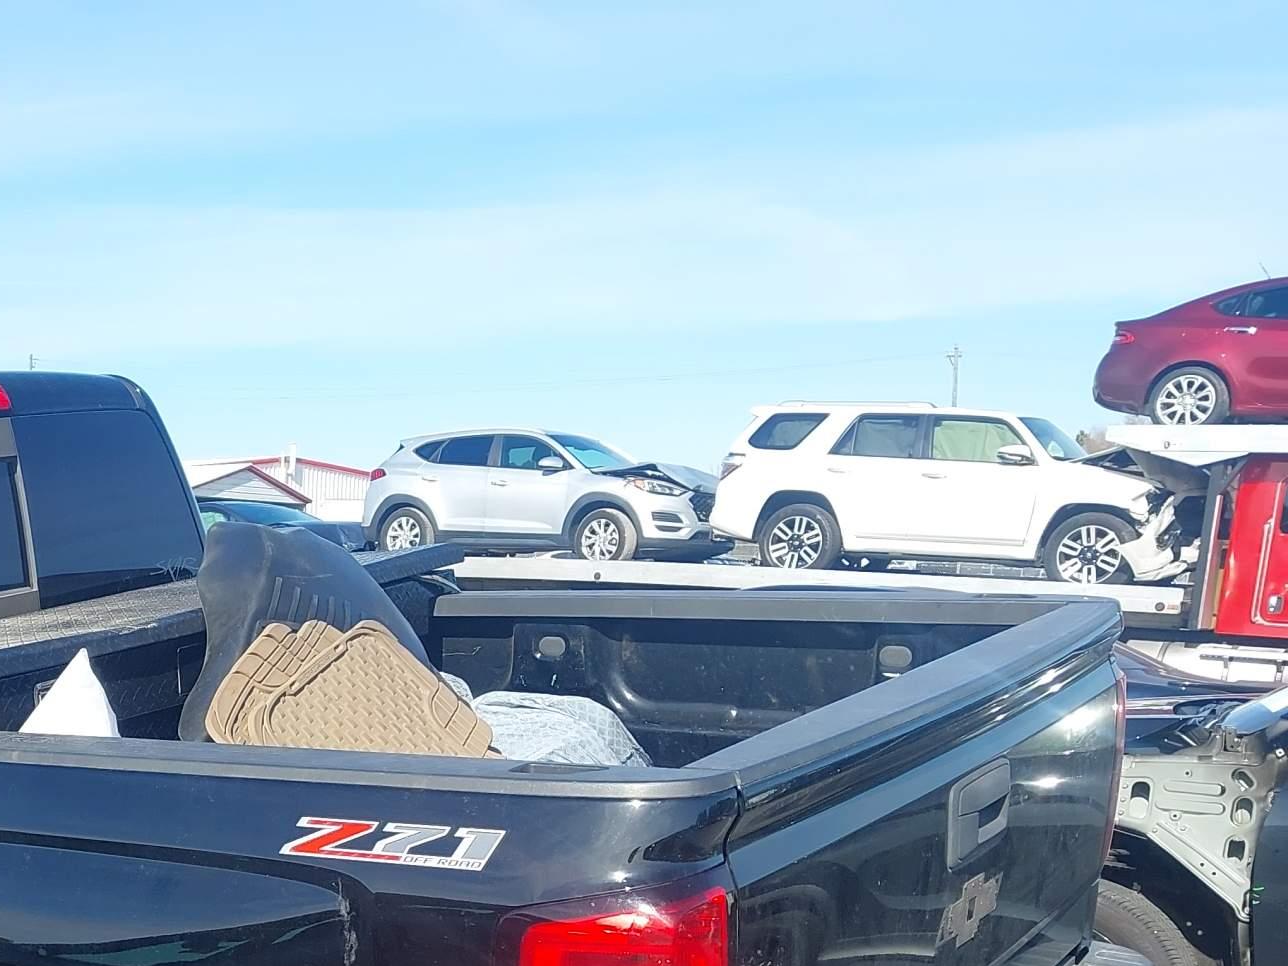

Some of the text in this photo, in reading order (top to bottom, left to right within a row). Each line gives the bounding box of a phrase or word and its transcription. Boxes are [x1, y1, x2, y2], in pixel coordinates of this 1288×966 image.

[279, 817, 506, 864] Z71
[403, 856, 481, 869] OFF ROAD
